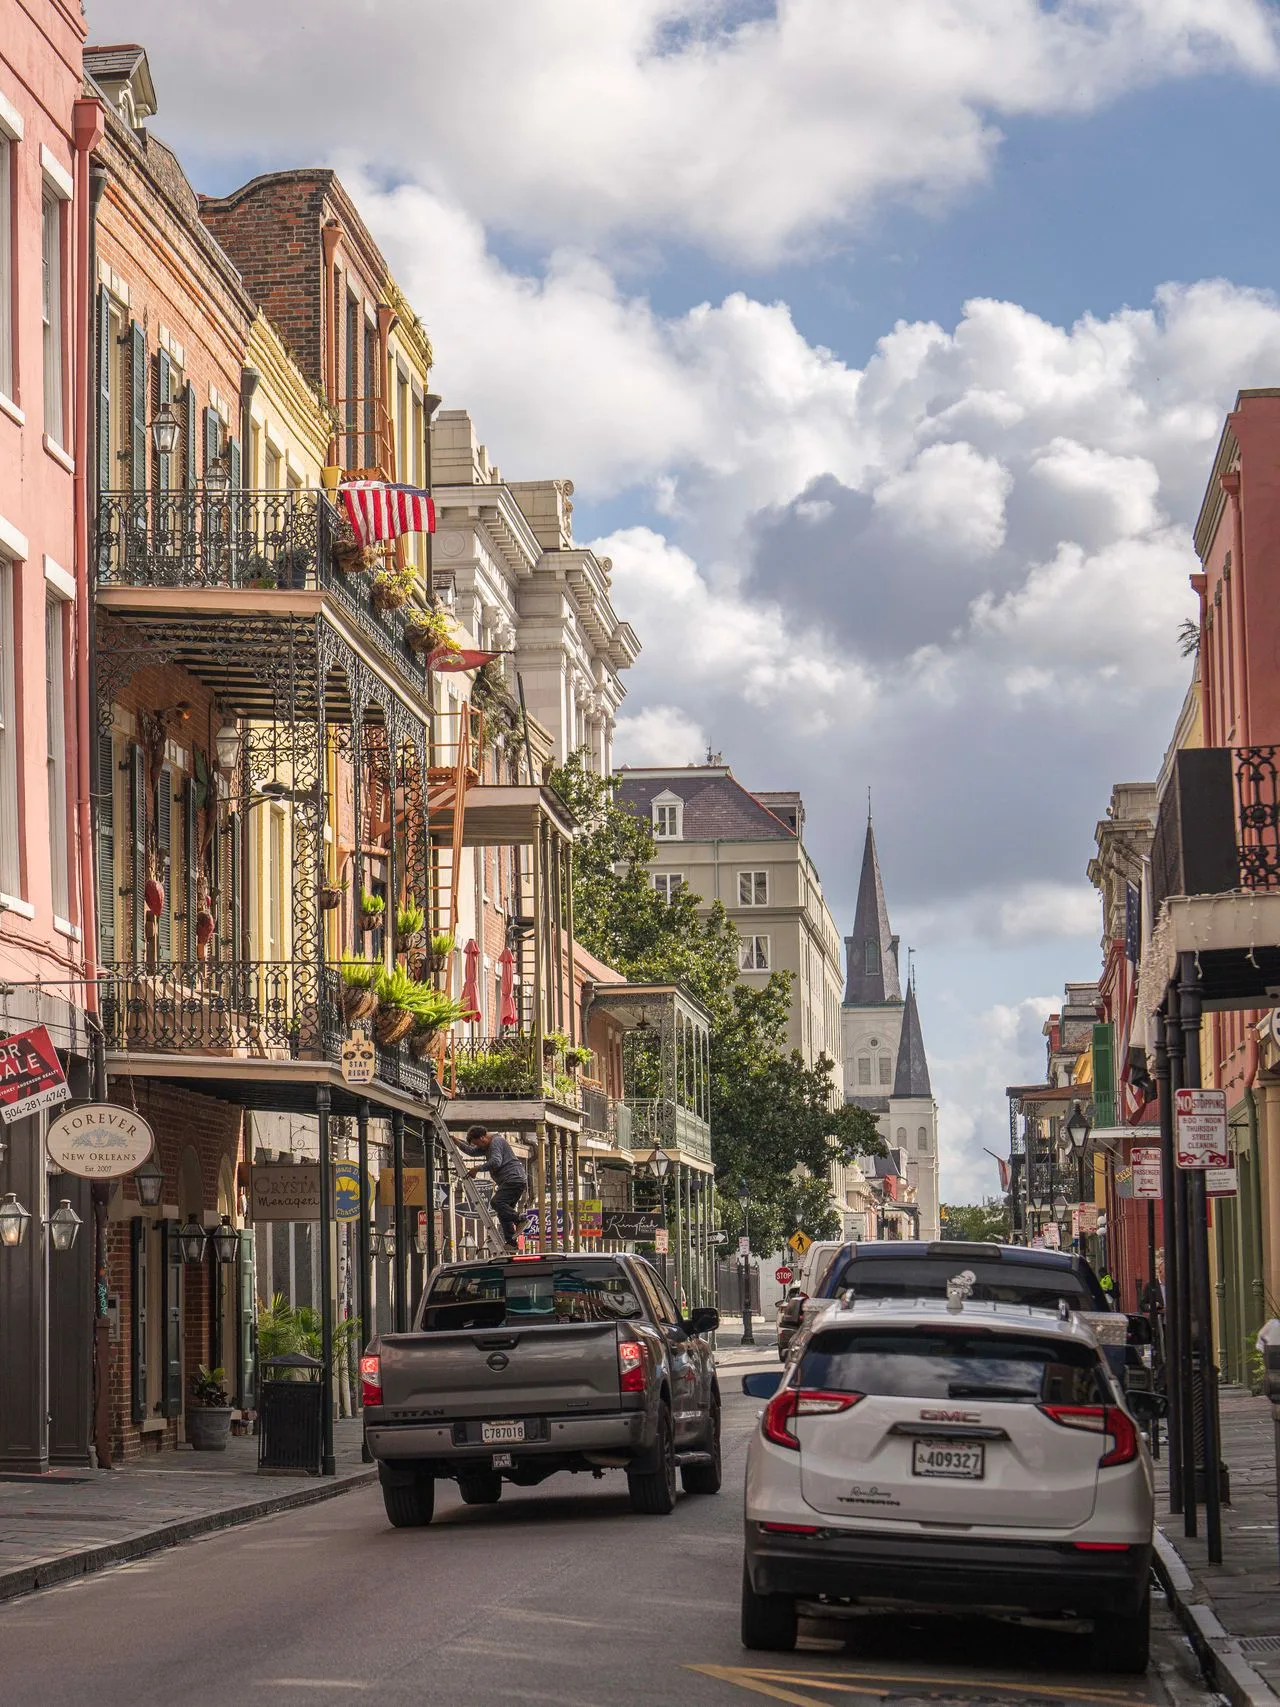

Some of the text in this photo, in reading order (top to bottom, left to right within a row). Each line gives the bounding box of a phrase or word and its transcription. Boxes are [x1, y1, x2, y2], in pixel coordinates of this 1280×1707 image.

[42, 1069, 59, 1079] REALTY
[4, 1087, 67, 1119] 504-281-4749
[1176, 1095, 1225, 1112] NO STOPPING
[61, 1113, 137, 1137] FOREVER
[1192, 1133, 1214, 1141] STREET
[62, 1152, 137, 1161] NEW ORLEANS
[1131, 1152, 1141, 1162] NO
[254, 1176, 320, 1194] CRYSTA
[776, 1272, 792, 1280] STOP
[390, 1408, 445, 1418] TITAN
[919, 1409, 982, 1423] GMC
[484, 1427, 524, 1439] C787018
[927, 1452, 981, 1469] 409327
